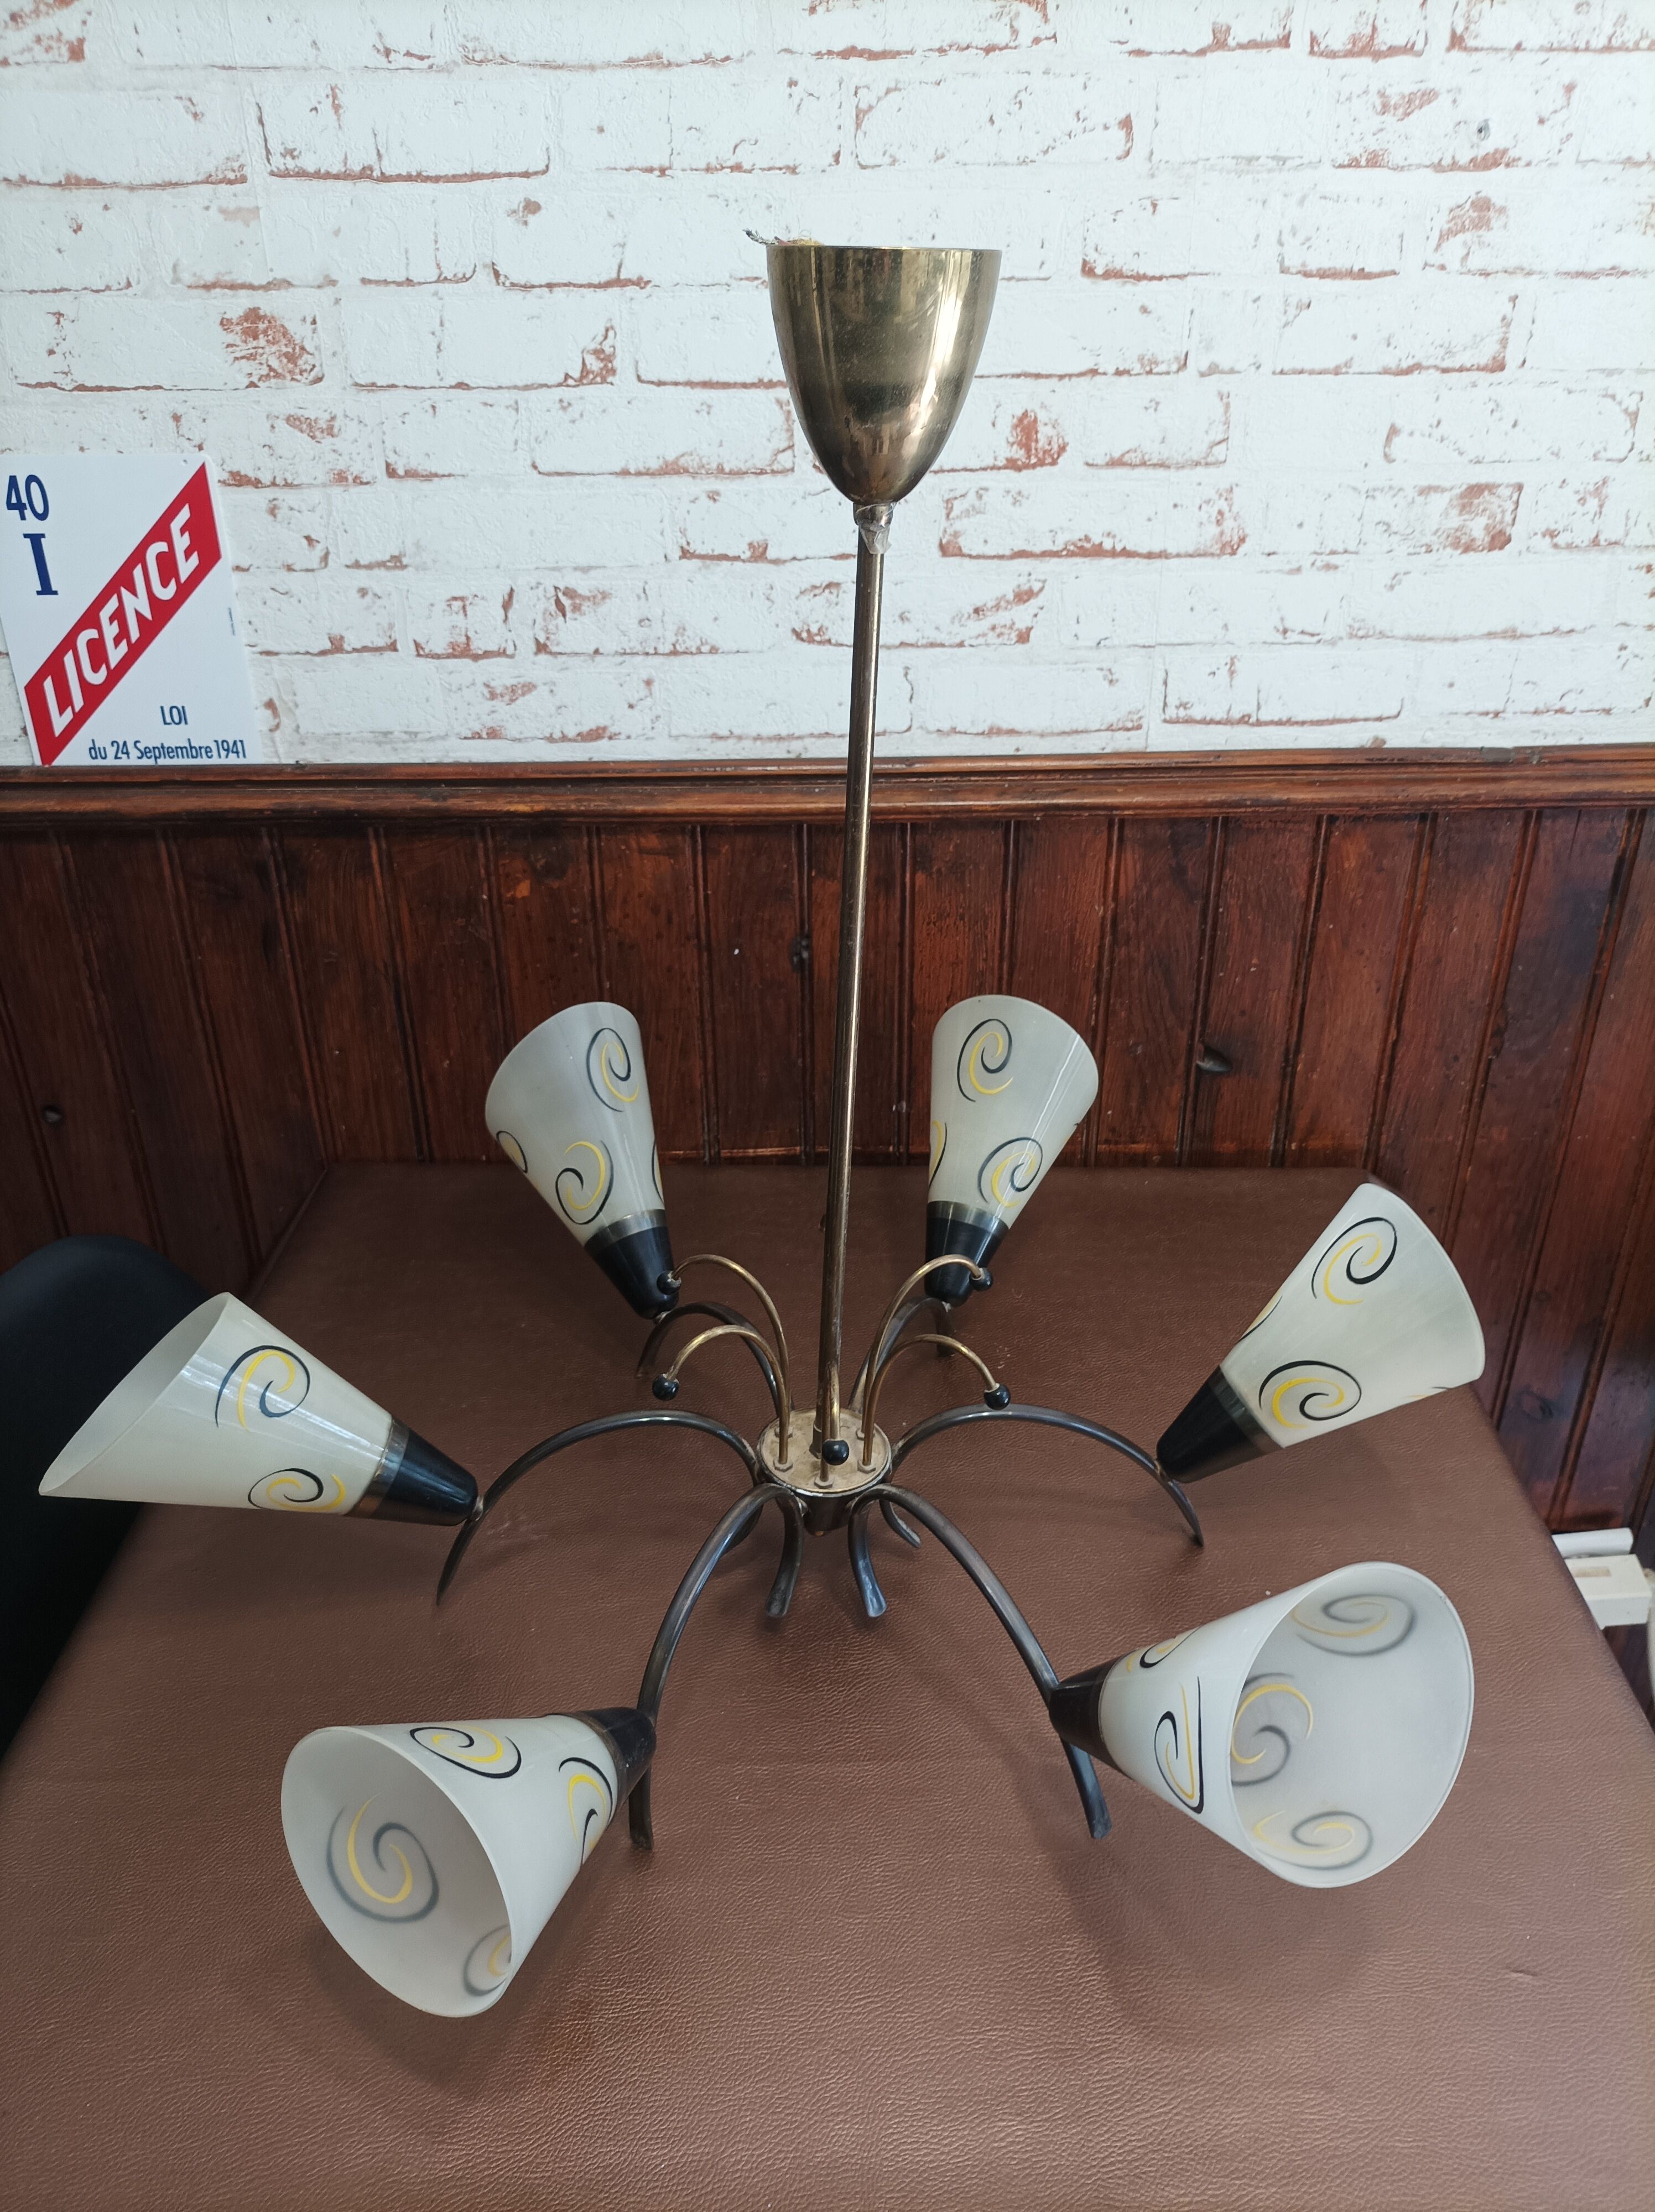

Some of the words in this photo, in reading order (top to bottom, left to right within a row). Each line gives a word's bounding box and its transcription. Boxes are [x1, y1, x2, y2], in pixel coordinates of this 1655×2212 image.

[6, 474, 49, 521] 40
[23, 533, 59, 596] I
[43, 503, 200, 738] LICENCE
[160, 705, 189, 726] LOI
[89, 739, 108, 760] du
[111, 740, 131, 760] 24
[133, 738, 214, 765] Septembre
[214, 739, 247, 759] 1941
